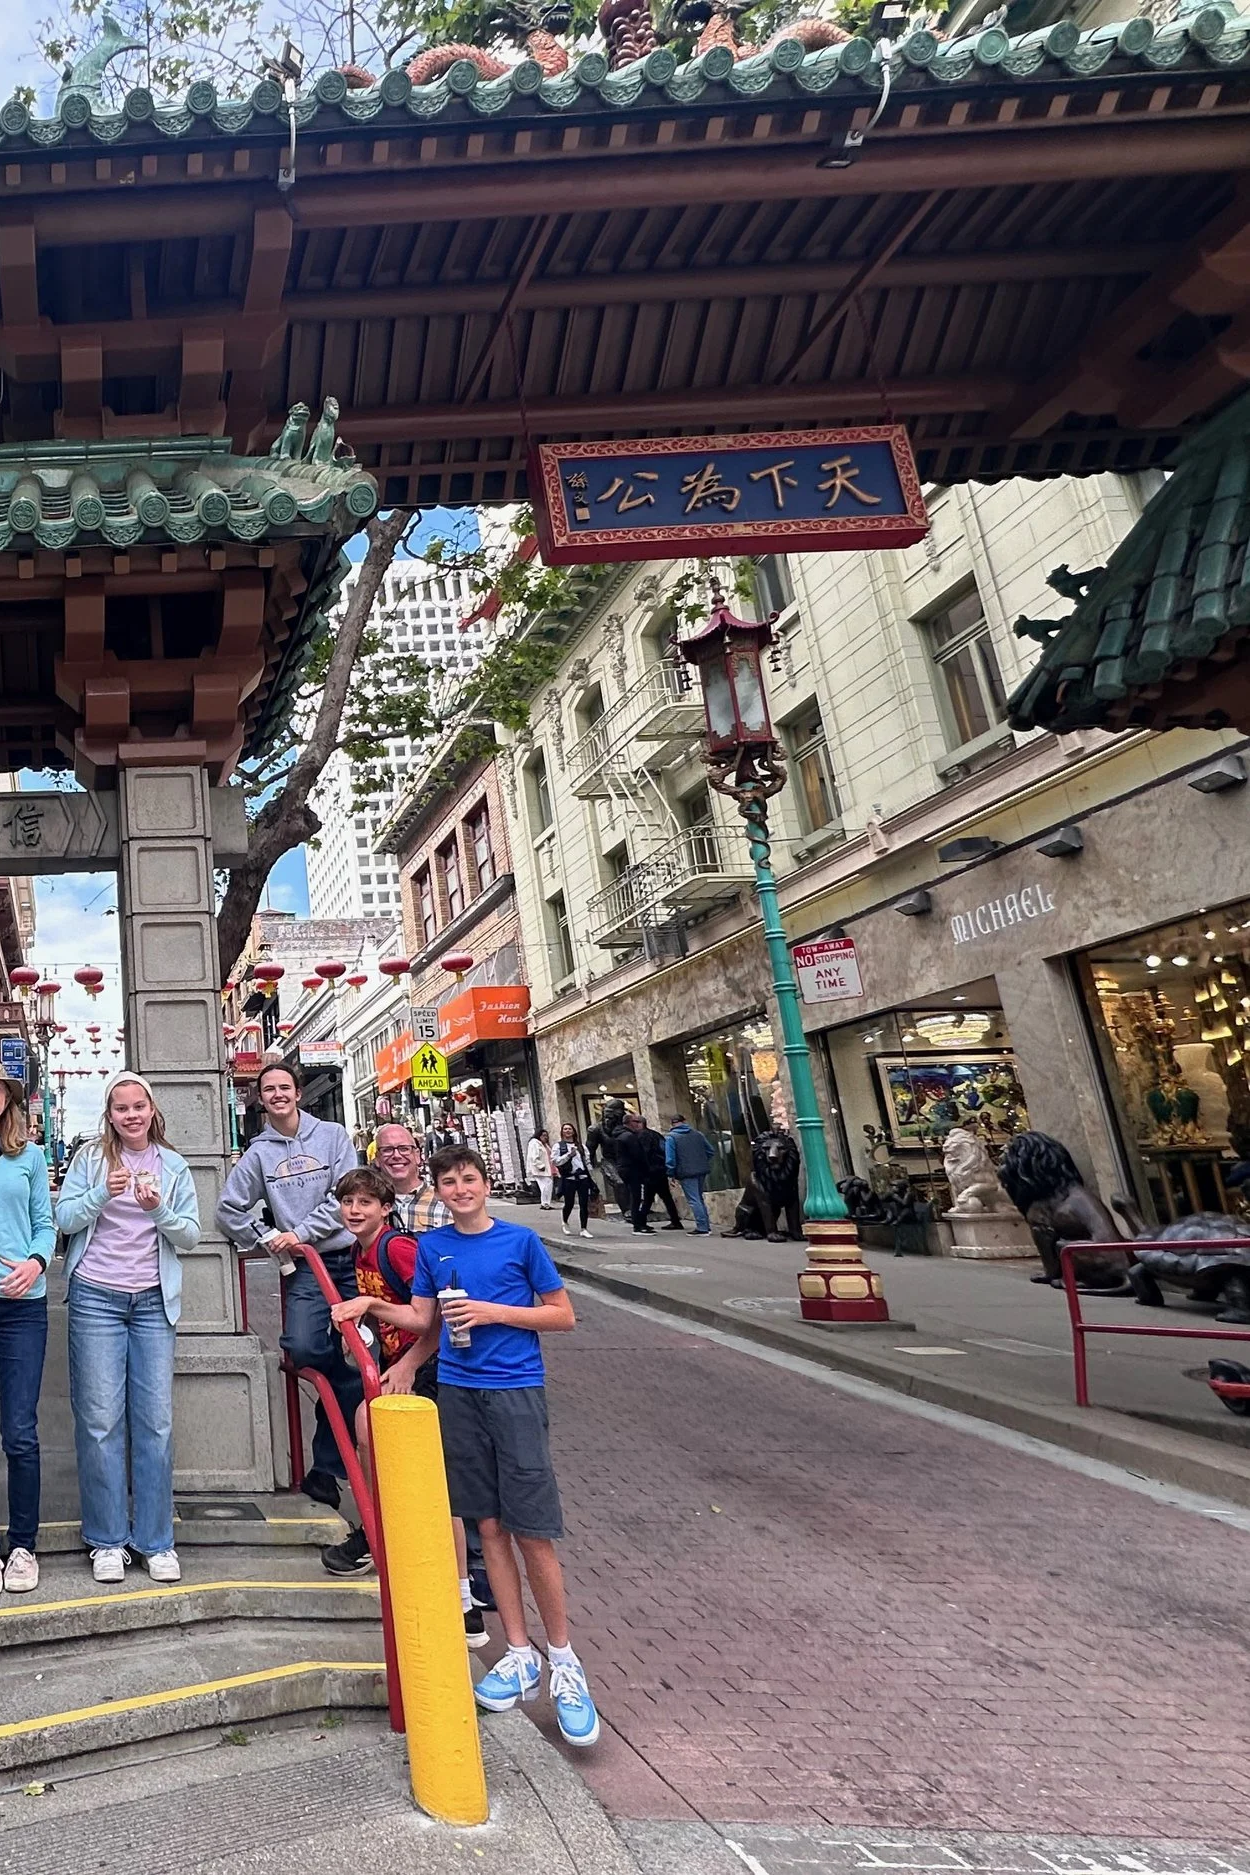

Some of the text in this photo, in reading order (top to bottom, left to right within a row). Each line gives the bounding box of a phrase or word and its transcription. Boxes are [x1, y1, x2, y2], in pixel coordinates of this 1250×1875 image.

[950, 883, 1056, 945] MICHAEL
[801, 941, 845, 954] TOW-AWAY
[795, 950, 855, 967] NO STOPPING
[815, 966, 841, 979] ANY
[814, 977, 847, 990] TIME
[479, 1001, 520, 1012] Fashion
[413, 1010, 437, 1018] SPEED
[497, 1013, 525, 1024] Hous
[418, 1025, 435, 1038] 15
[417, 1079, 444, 1088] AHEAD
